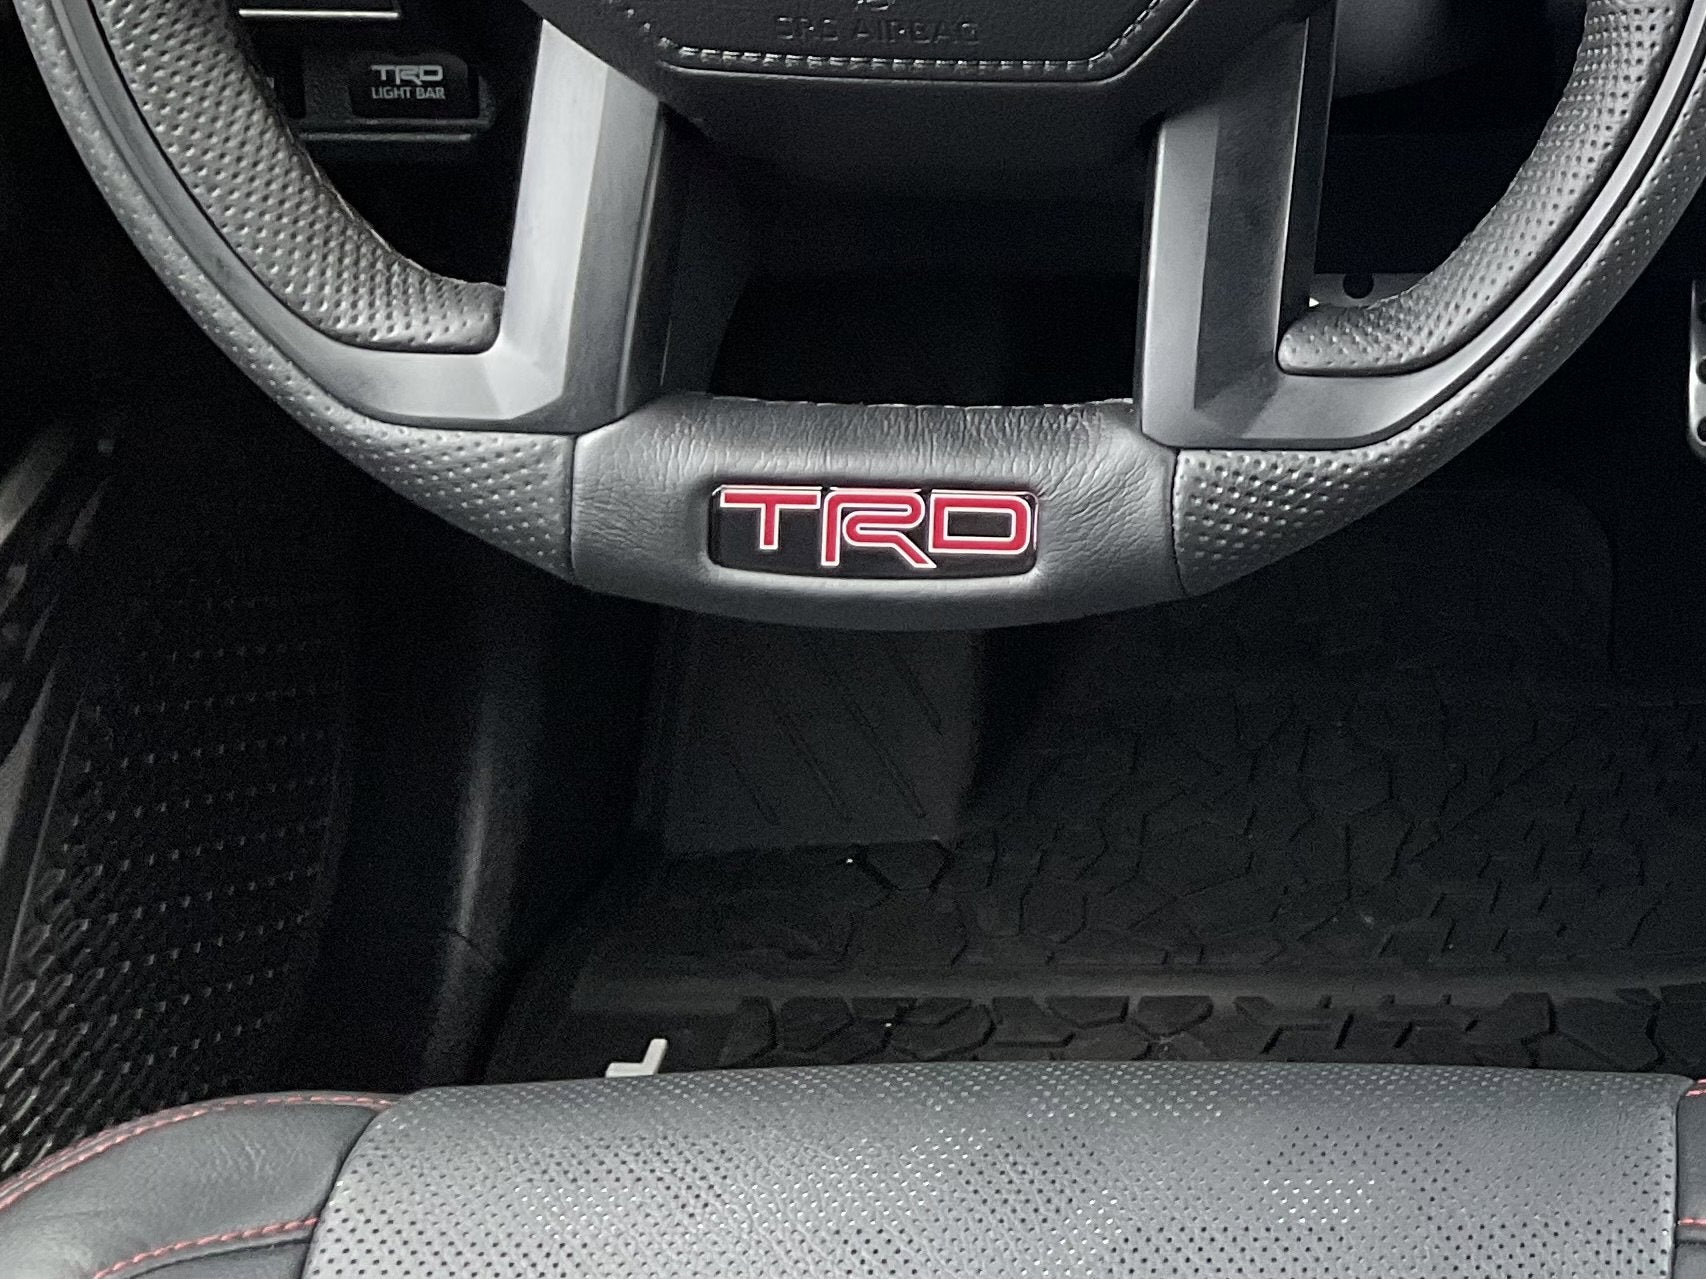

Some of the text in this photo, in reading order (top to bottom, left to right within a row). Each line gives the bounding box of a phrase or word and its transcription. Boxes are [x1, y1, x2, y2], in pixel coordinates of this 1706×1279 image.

[370, 64, 443, 85] TRD
[371, 87, 446, 100] LIGHT BAR
[719, 488, 1032, 569] TRD
